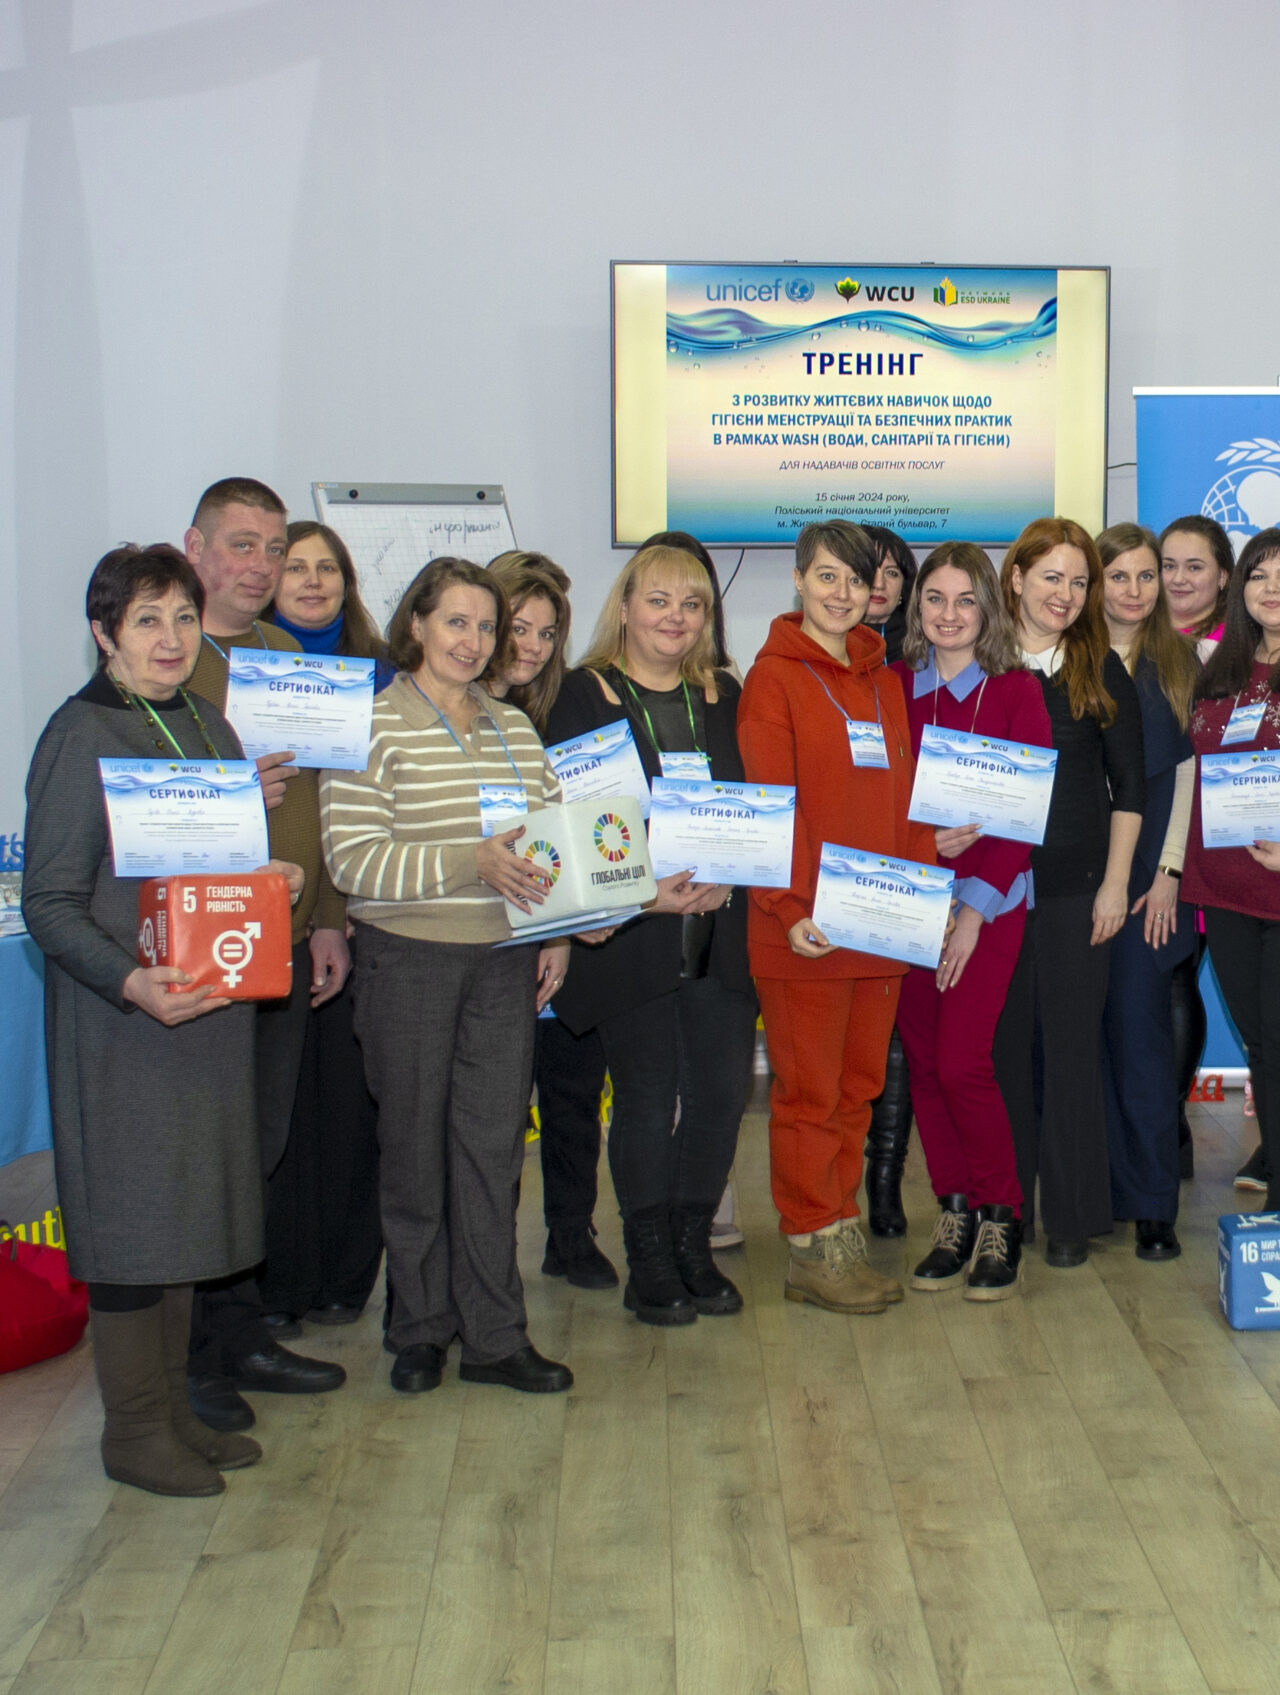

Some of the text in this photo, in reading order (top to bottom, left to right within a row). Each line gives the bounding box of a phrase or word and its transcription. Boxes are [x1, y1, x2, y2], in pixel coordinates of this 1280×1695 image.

[706, 278, 782, 302] unicef
[866, 286, 915, 302] WCU
[960, 296, 1011, 305] ESD UKRAINE
[802, 352, 924, 376] ТРЕНІНГ
[732, 394, 992, 409] З РОЗВИТКУ ЖИТТЄВИХ НАВИЧОК ЩОДО
[712, 411, 1013, 428] ГІГІЄНИ МЕНСТРУАЦІЇ ТА БЕЗПЕЧНИХ ПРАКТИК
[713, 431, 1011, 448] В РАМКАХ WASH (ВОДИ, САНІТАРІЇ ТА ГІГІЄНИ)
[779, 460, 946, 471] ДЛЯ НАДАВАЧІВ ОСВІТНІХ ПОСЛУГ
[815, 492, 911, 503] 15 січня 2024 року,
[774, 505, 951, 516] Поліський національний університет
[897, 519, 938, 529] бульвар,
[941, 519, 948, 528] 7
[304, 660, 323, 669] WCU
[269, 681, 336, 696] СЕРТИФІКАТ
[564, 743, 583, 754] WCU
[990, 743, 1009, 752] WCU
[181, 765, 202, 773] WCU
[556, 759, 602, 781] ТИФІКАТ
[956, 756, 1018, 776] СЕРТИФІКАТ
[149, 788, 221, 799] СЕРТИФІКАТ
[690, 807, 756, 820] СЕРТИФІКАТ
[889, 863, 907, 872] WCU
[591, 866, 632, 885] ГЛОБАЛЬНІ
[206, 886, 253, 898] ГЕНДЕРНА
[856, 876, 917, 896] СЕРТИФІКАТ
[183, 886, 197, 913] 5
[206, 900, 246, 913] РІВНІСТЬ
[1261, 1240, 1277, 1250] МИР
[1239, 1241, 1259, 1264] 16
